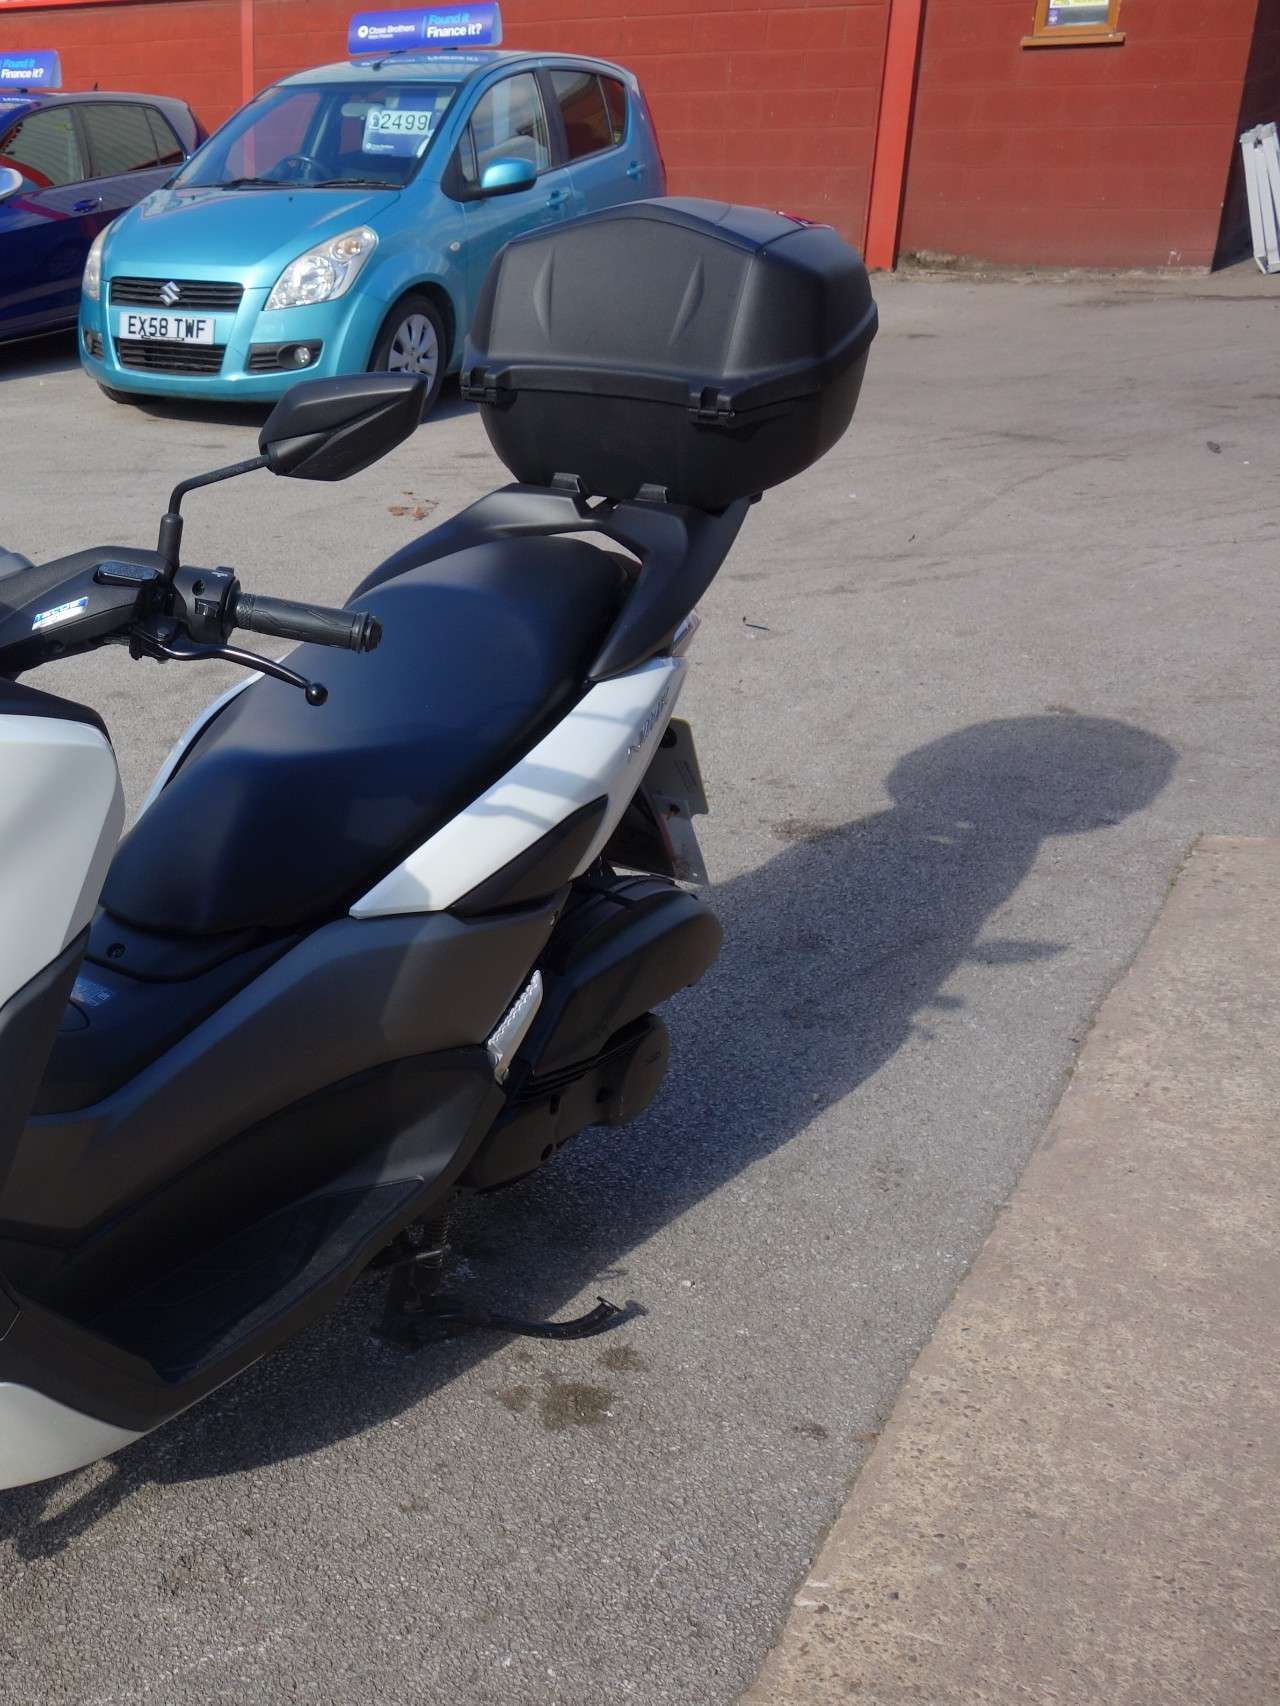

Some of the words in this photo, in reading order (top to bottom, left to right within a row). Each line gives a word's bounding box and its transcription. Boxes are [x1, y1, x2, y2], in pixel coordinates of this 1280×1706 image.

[429, 13, 460, 24] Found
[461, 13, 470, 23] it
[427, 25, 466, 38] Finance
[468, 23, 483, 36] it?
[1, 69, 31, 79] Finance
[32, 68, 45, 78] it?
[128, 315, 168, 336] EX58
[174, 318, 206, 338] TWF
